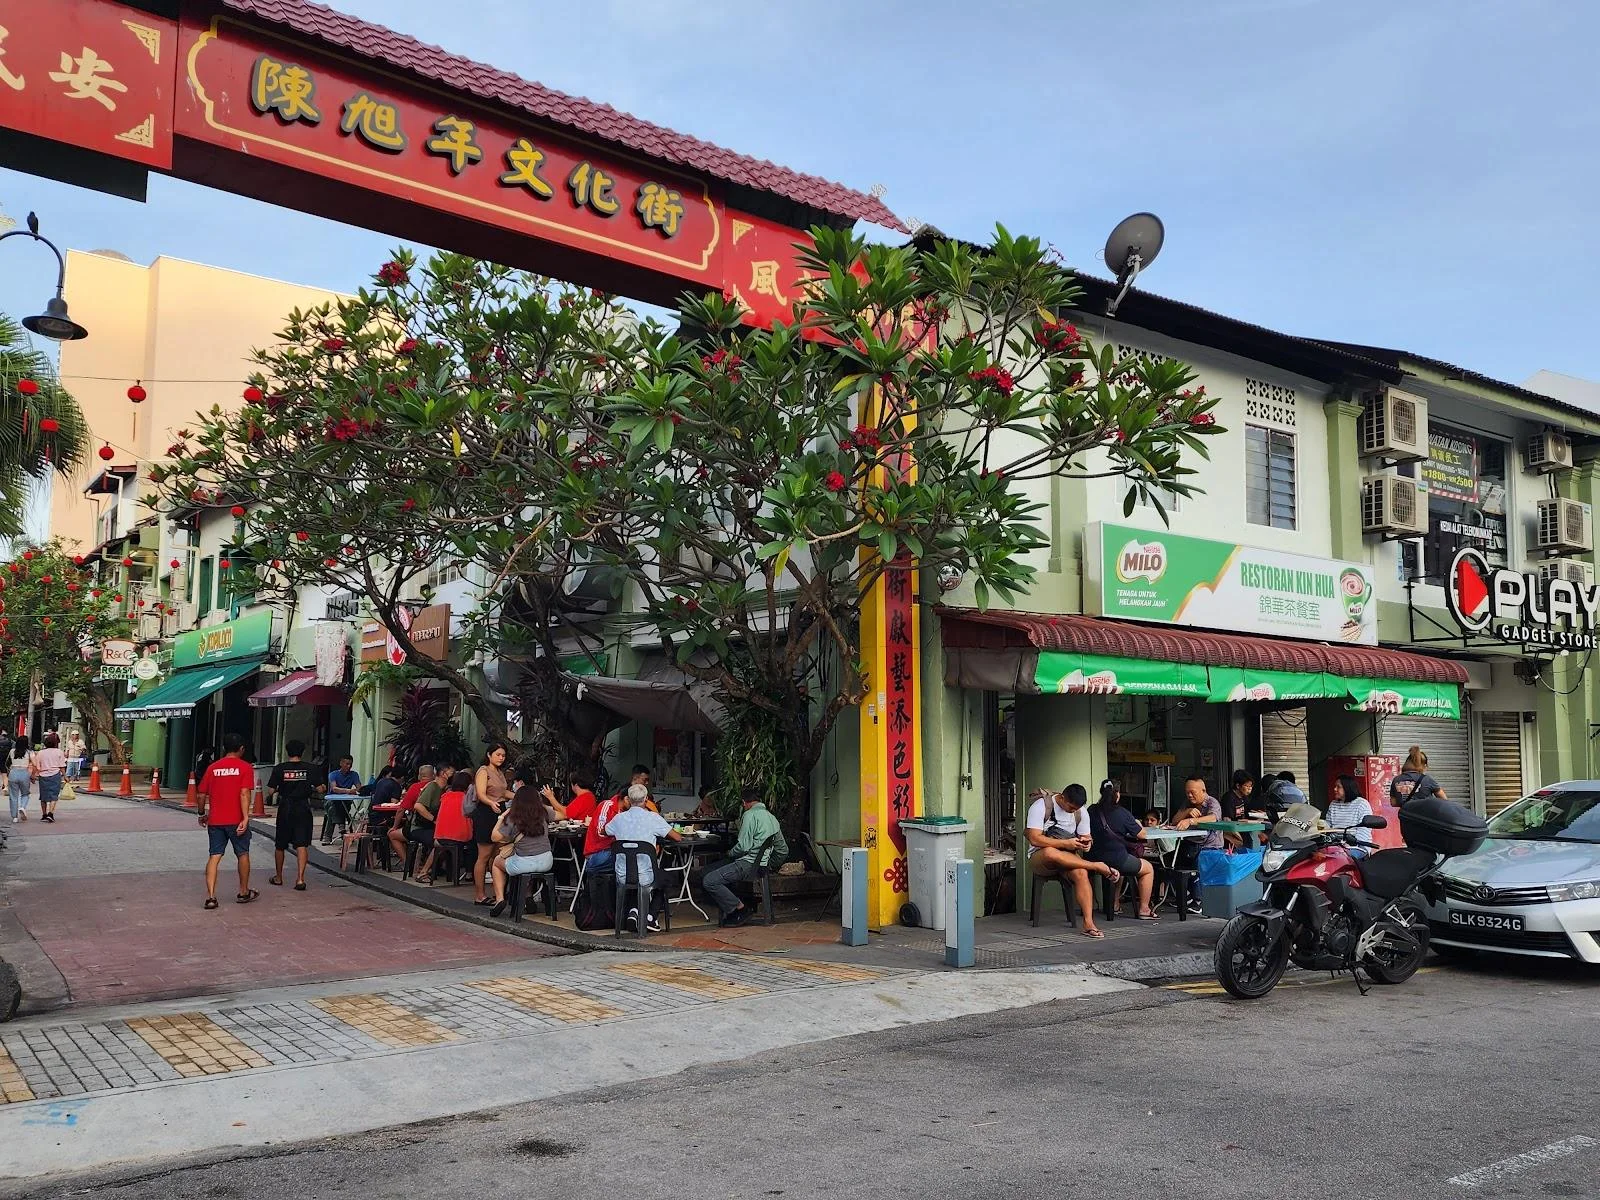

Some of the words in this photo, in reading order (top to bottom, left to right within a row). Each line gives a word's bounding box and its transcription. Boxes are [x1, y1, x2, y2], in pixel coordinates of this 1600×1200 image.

[252, 55, 686, 238] 陳旭年文化街
[1123, 552, 1163, 572] MILO
[1240, 562, 1294, 594] RESTORAN
[1296, 570, 1313, 597] KIN
[1315, 573, 1335, 599] HUA
[1259, 594, 1321, 622] 錦華茶餐室
[1502, 624, 1554, 645] GADGET
[1560, 631, 1598, 649] STORE
[102, 666, 134, 674] ROAST
